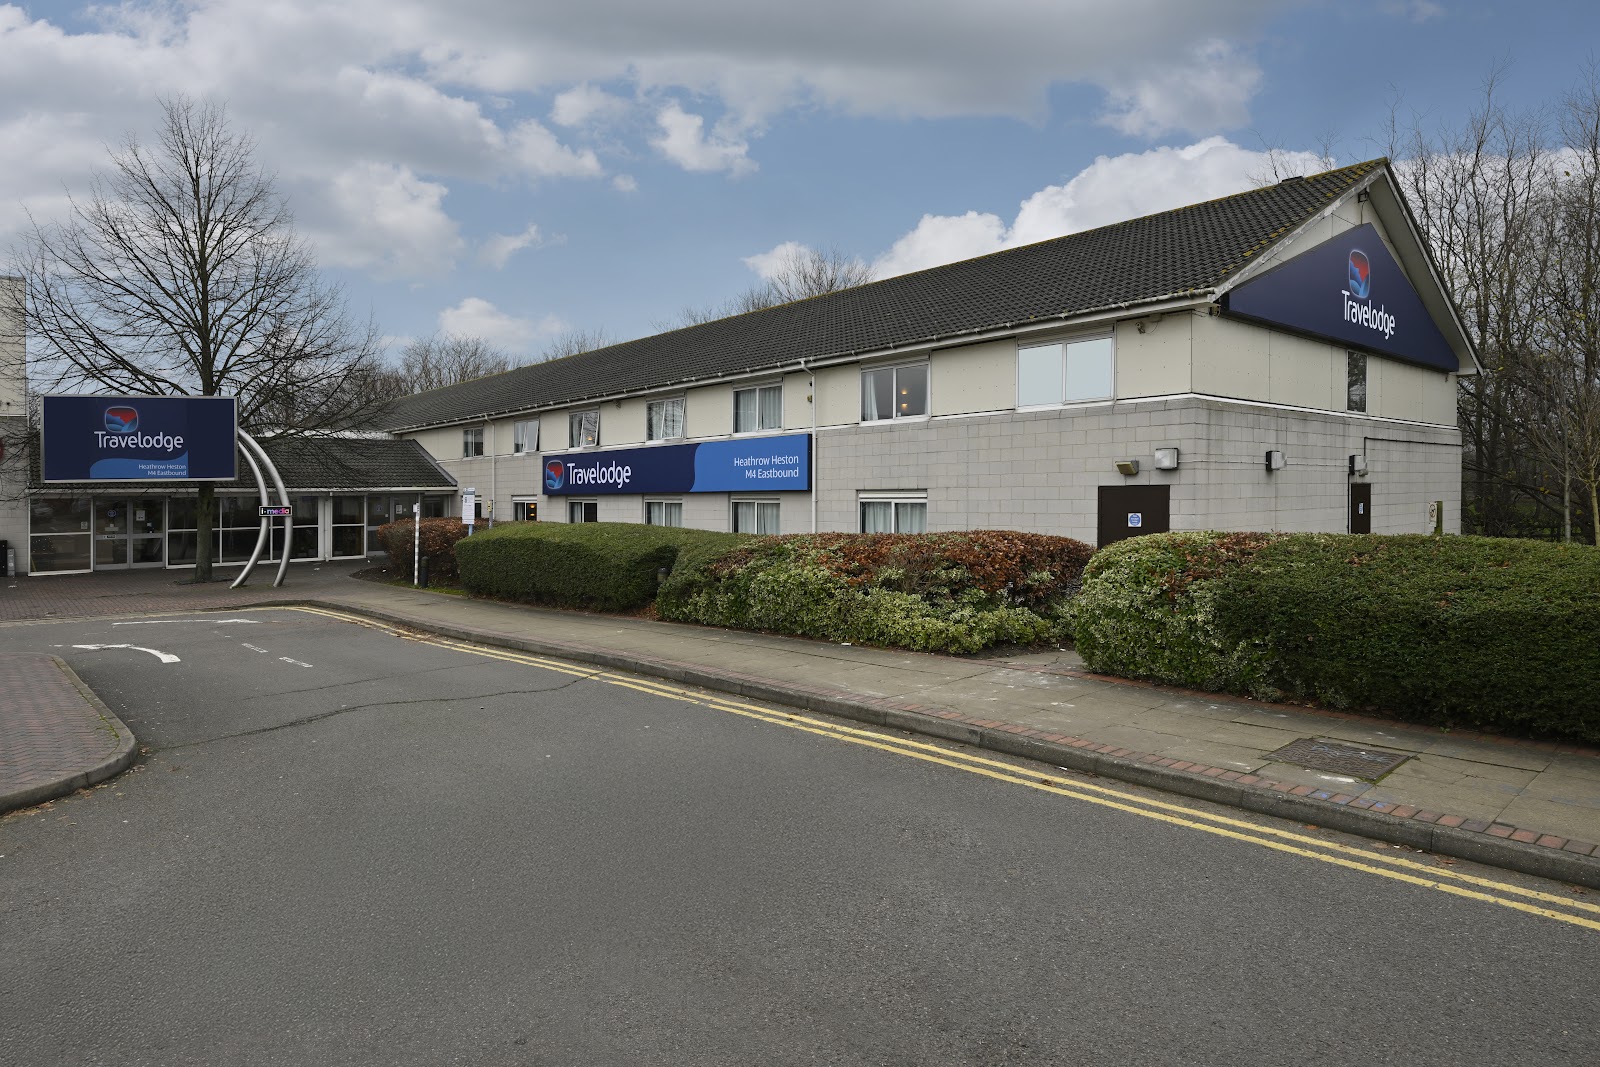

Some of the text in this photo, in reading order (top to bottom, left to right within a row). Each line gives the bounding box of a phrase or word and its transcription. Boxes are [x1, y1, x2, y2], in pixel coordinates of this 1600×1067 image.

[1341, 289, 1396, 340] Travelodge
[94, 431, 184, 452] Travelodge
[733, 454, 799, 467] Heathrow Heston
[567, 460, 632, 489] Travelodge
[745, 467, 799, 479] M4 Eastbound
